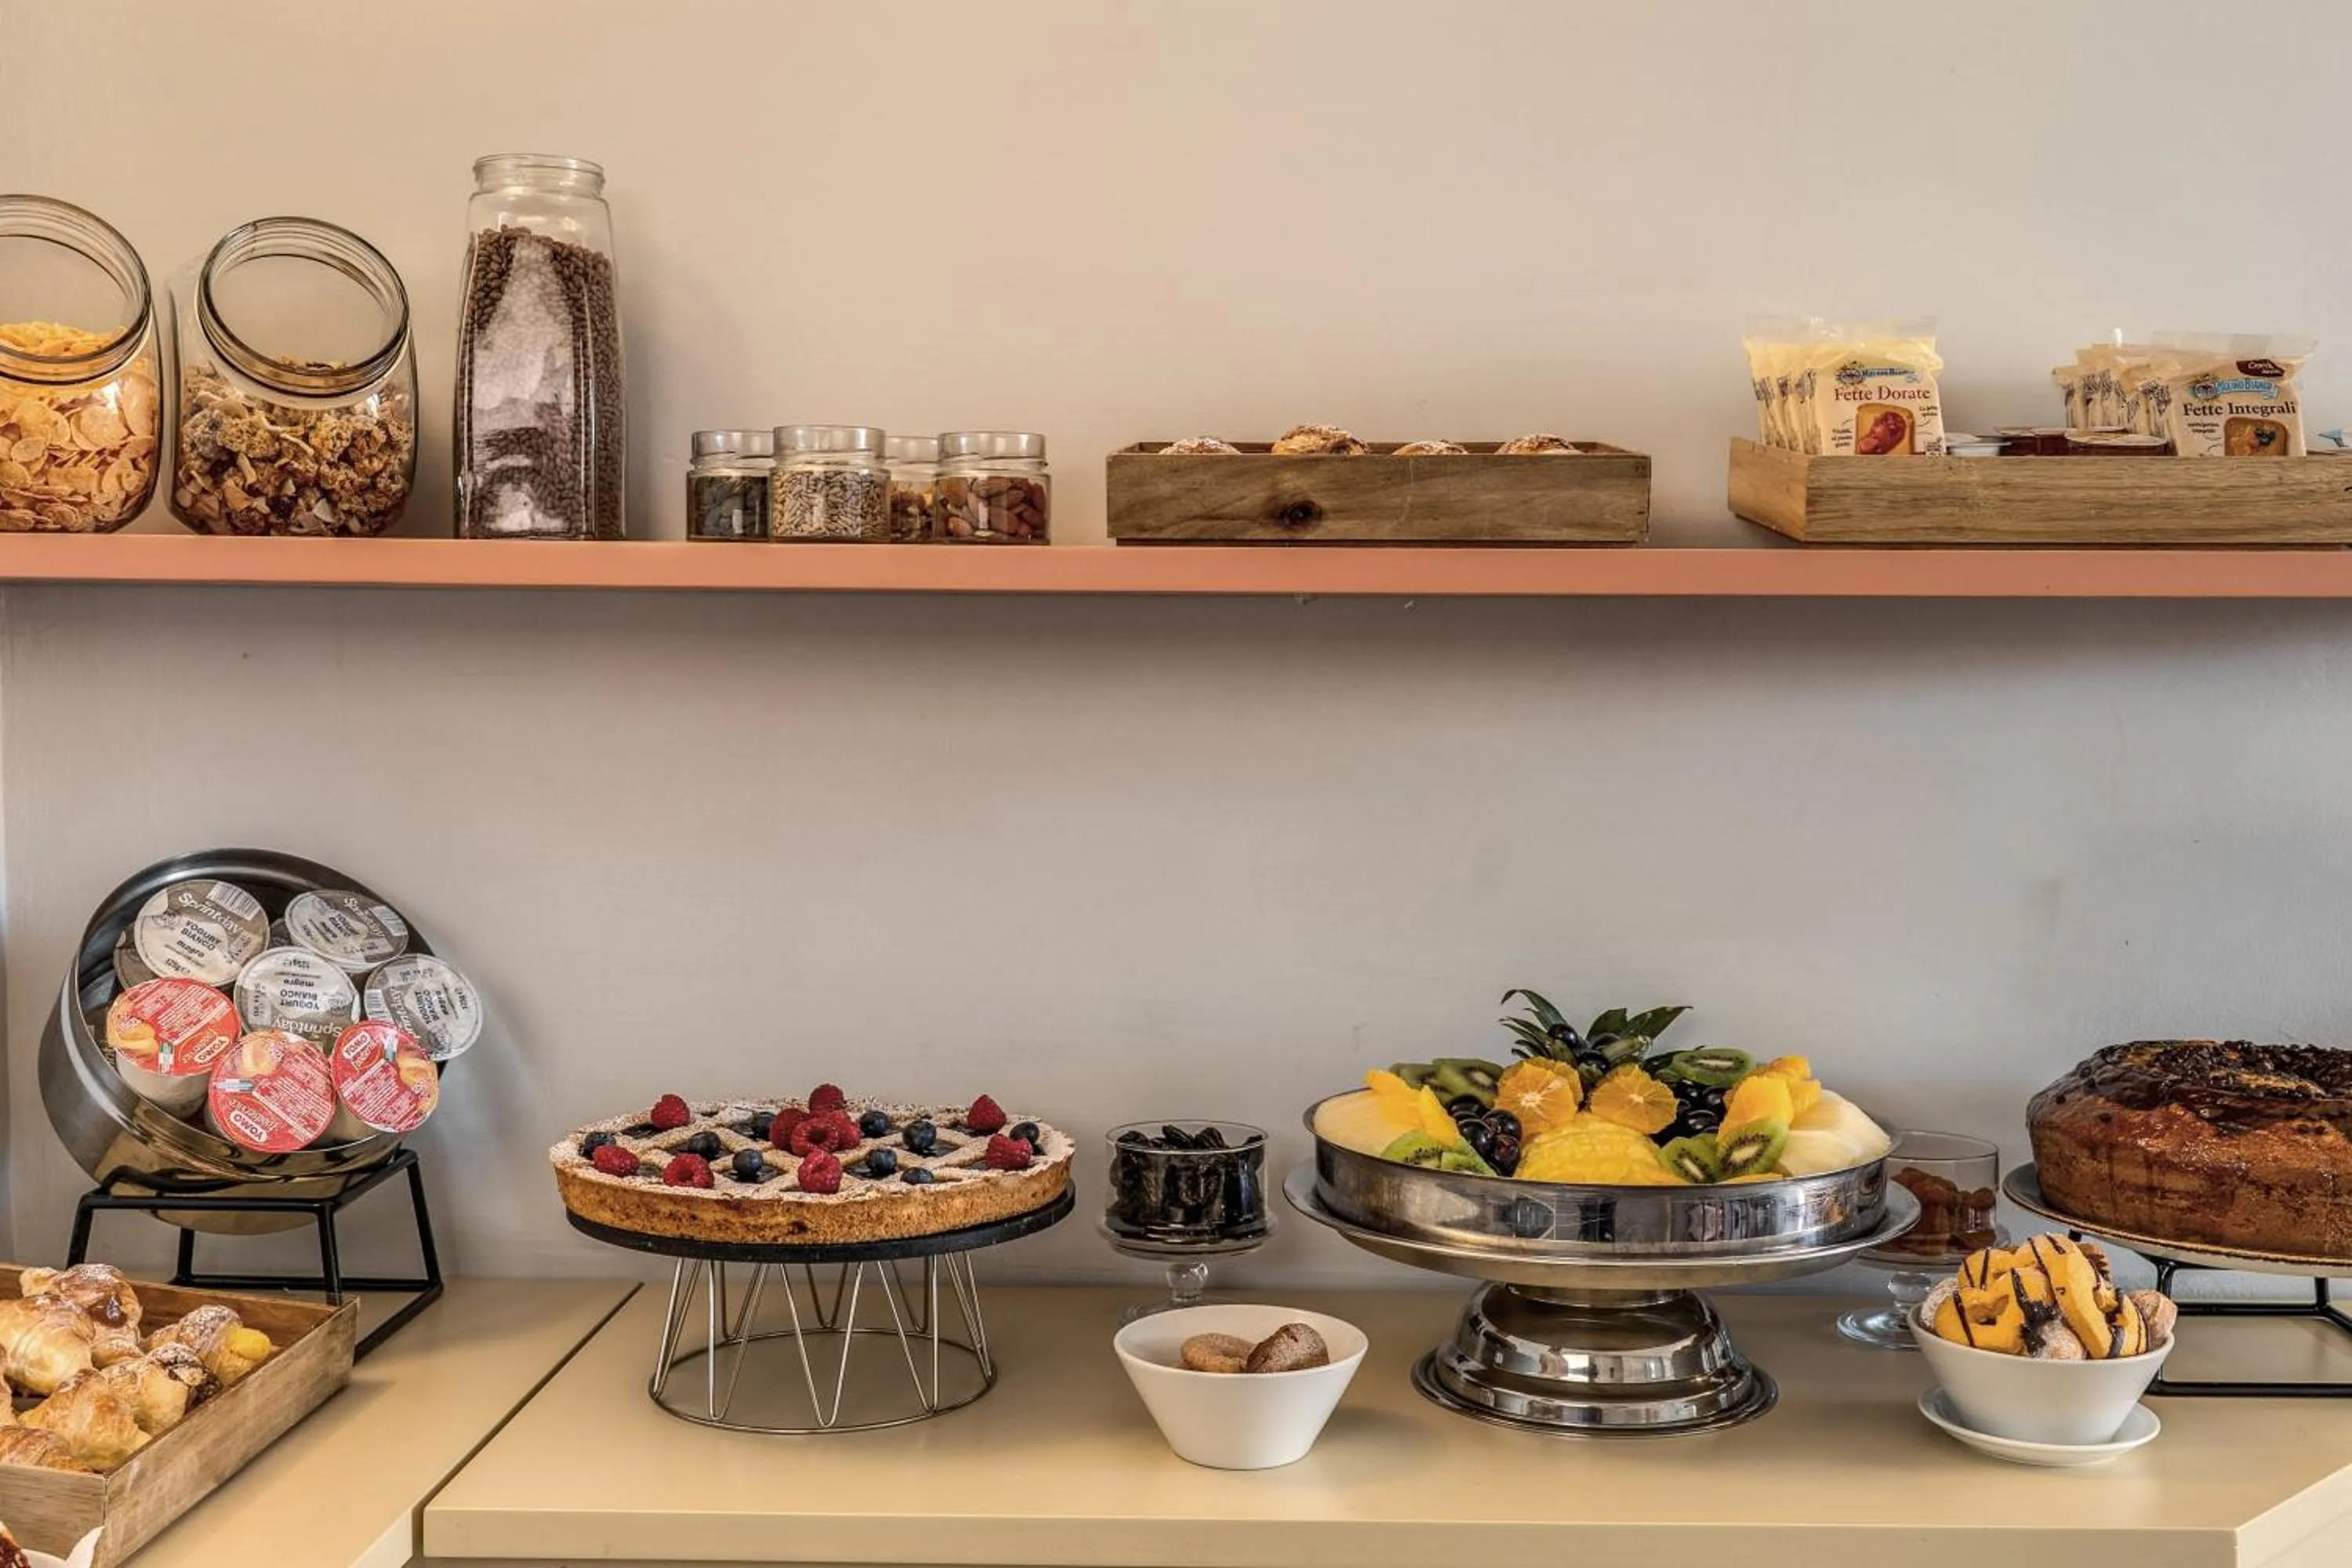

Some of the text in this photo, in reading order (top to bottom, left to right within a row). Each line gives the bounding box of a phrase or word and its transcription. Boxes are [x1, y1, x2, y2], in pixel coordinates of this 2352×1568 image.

[1835, 385, 1931, 401] Fette Dorate
[2183, 401, 2296, 417] Fette Integrali
[181, 927, 216, 951] BIANCO
[186, 920, 222, 945] YOGURT
[176, 940, 205, 958] magro
[279, 989, 318, 1001] BIANCO
[280, 998, 320, 1011] YOGURT
[198, 1038, 227, 1061] YOMO
[347, 1033, 368, 1055] YOMO
[233, 1112, 265, 1142] YOMO
